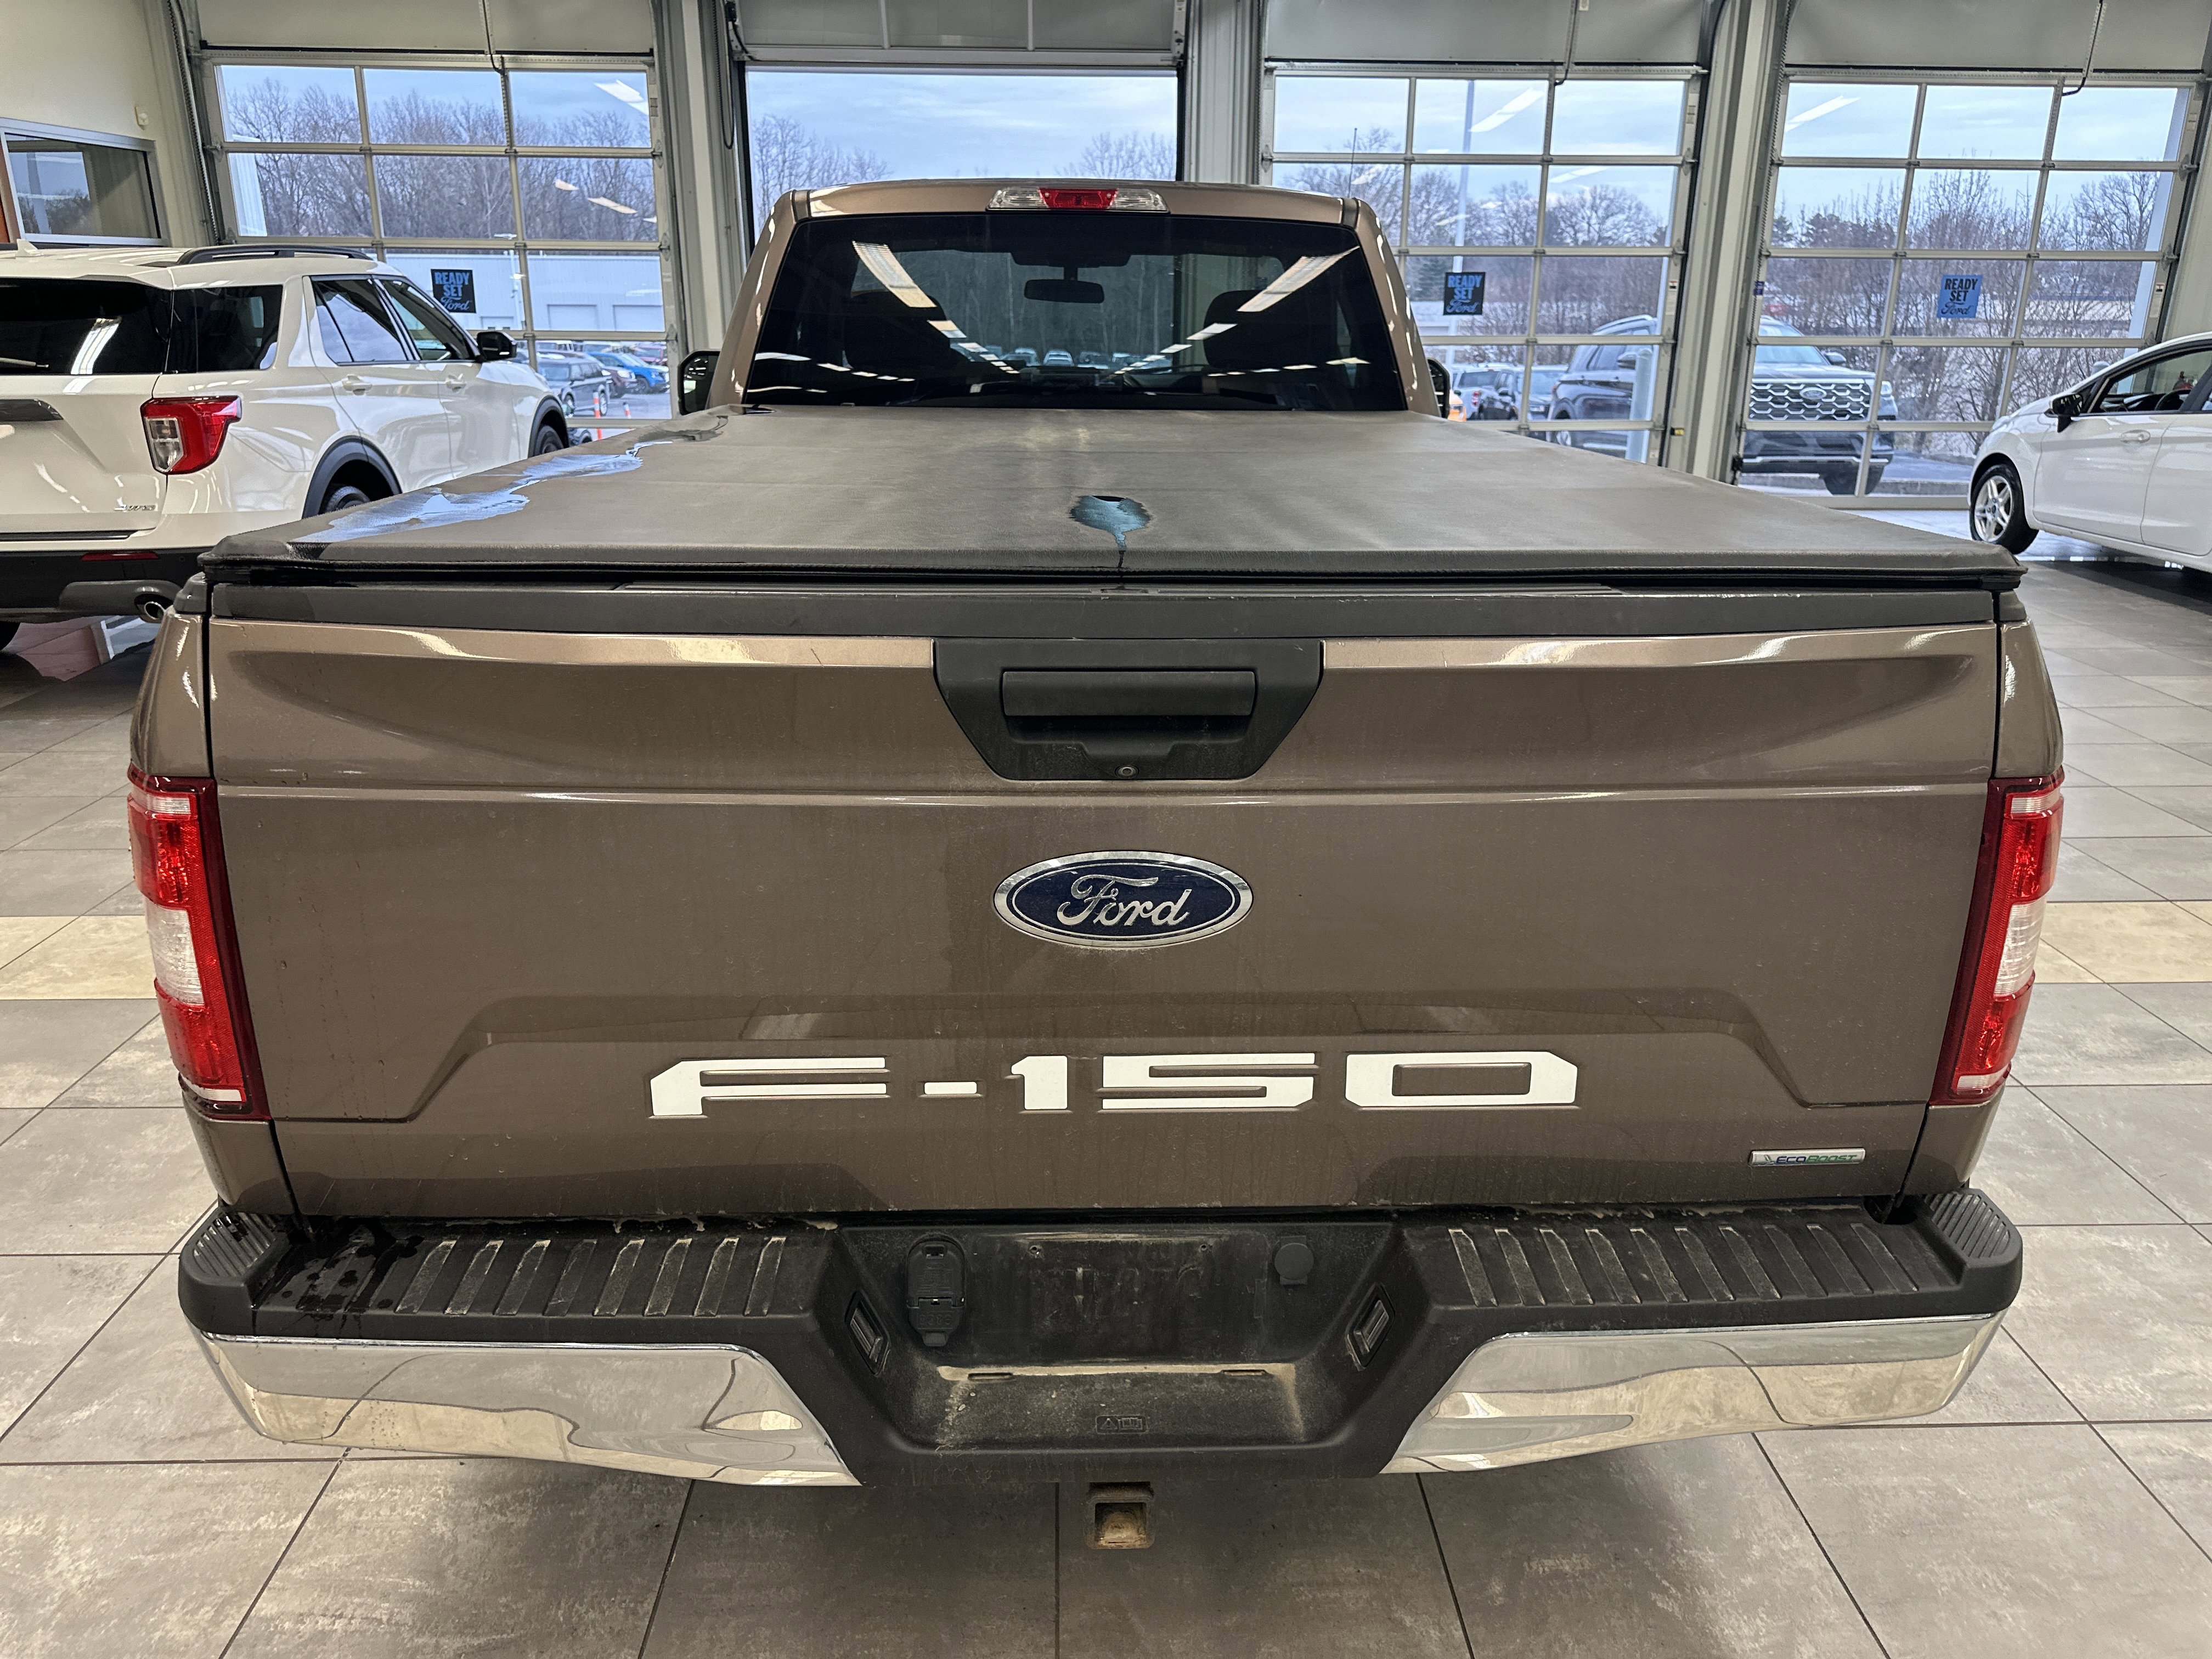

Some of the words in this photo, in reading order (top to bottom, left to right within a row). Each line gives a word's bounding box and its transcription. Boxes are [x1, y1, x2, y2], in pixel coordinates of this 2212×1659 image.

[434, 272, 470, 285] READY
[1448, 275, 1483, 287] READY
[1944, 278, 1978, 290] READY
[443, 284, 463, 297] SET
[1454, 287, 1474, 300] SET
[1949, 290, 1968, 302] SET
[441, 296, 470, 311] Ford
[1446, 299, 1480, 313] Ford
[1941, 302, 1971, 315] Ford
[1057, 874, 1190, 927] Ford
[650, 1051, 1578, 1116] F-150
